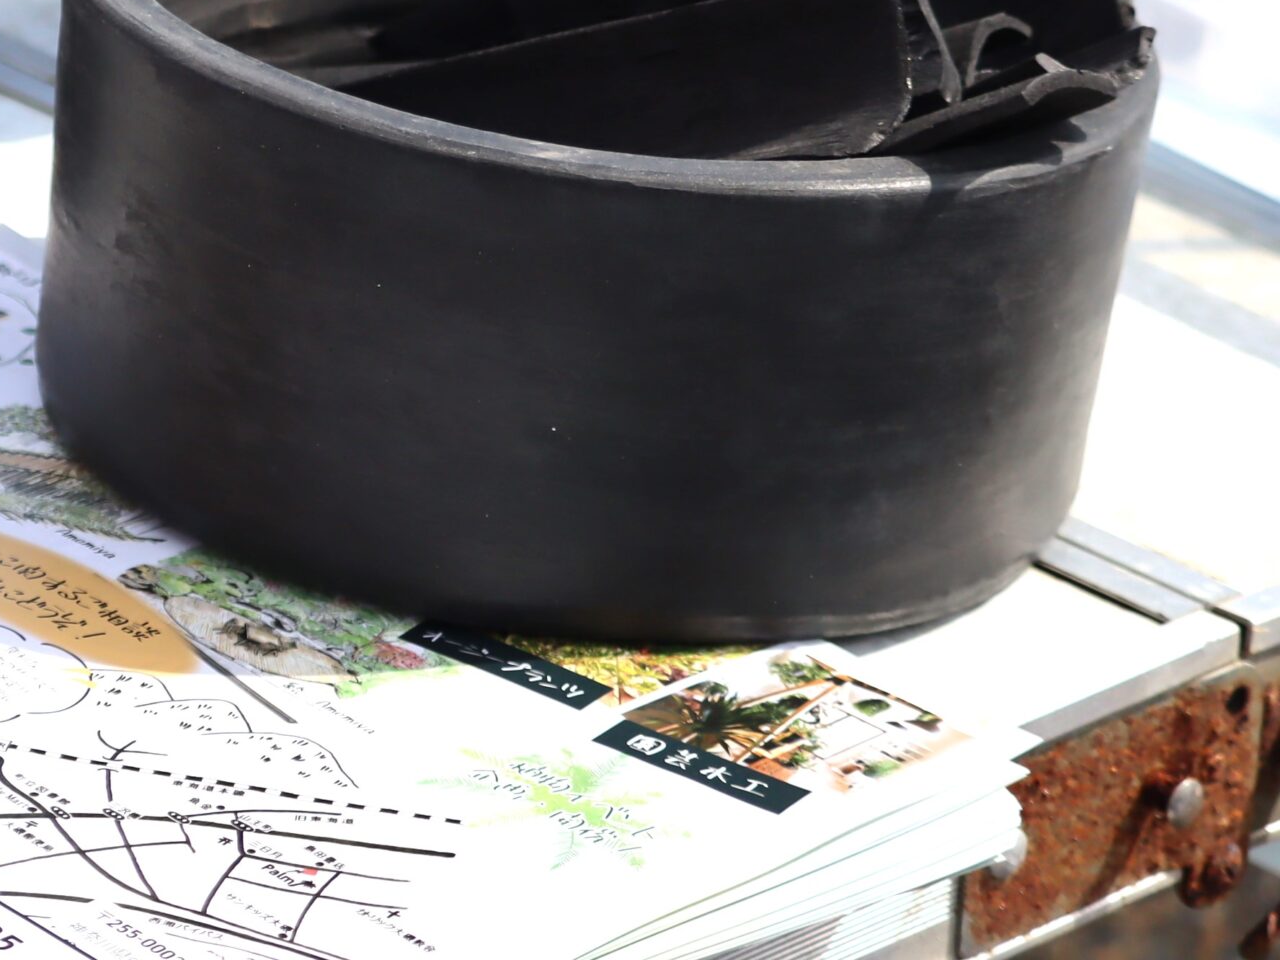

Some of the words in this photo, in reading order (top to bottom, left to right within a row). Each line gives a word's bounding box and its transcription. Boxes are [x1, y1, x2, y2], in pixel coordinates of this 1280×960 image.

[626, 734, 769, 797] 園芸木工
[262, 864, 295, 887] Palm
